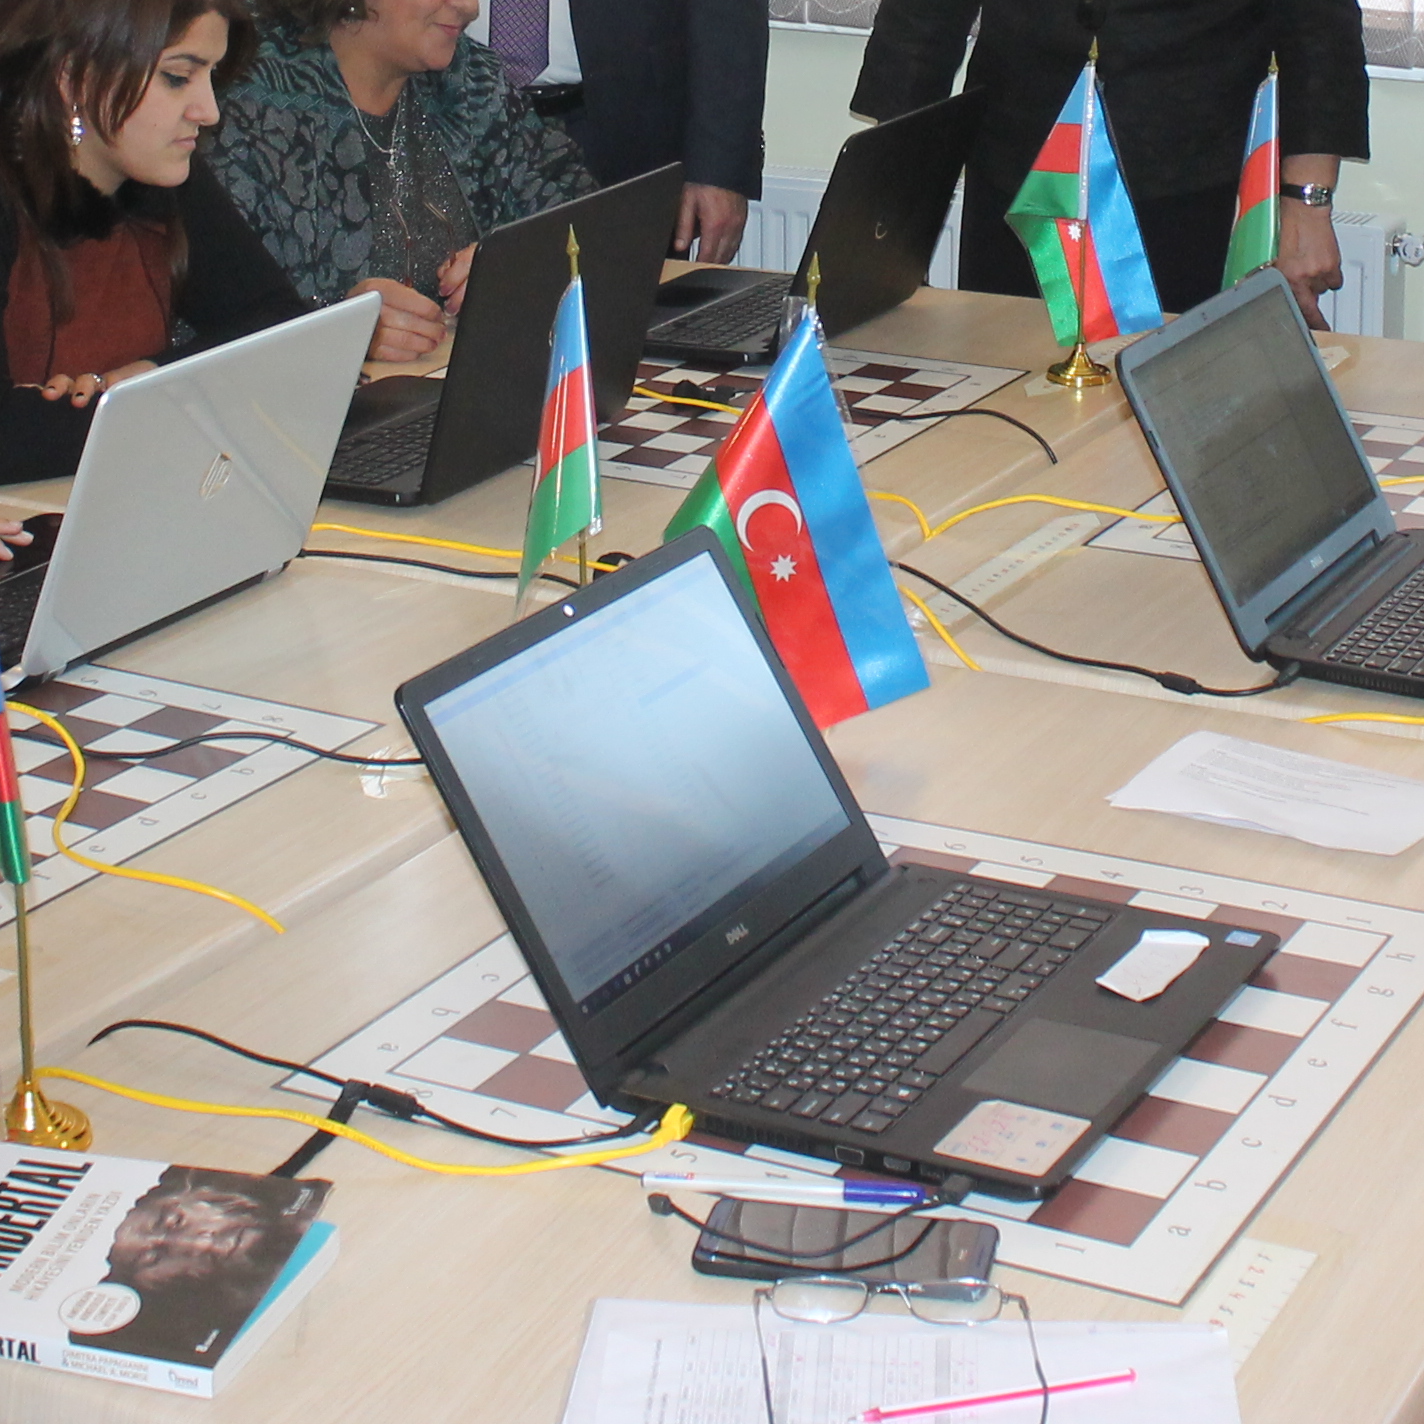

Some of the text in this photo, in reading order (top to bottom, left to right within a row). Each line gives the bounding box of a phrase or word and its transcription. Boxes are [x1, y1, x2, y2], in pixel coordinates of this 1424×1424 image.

[1100, 868, 1125, 882] 4
[1179, 883, 1205, 896] 3
[1261, 898, 1288, 911] 2
[1387, 949, 1416, 963] h
[1367, 985, 1395, 998] g
[1331, 1018, 1358, 1031] f
[1307, 1057, 1328, 1070] e
[1268, 1094, 1297, 1108] d
[1241, 1136, 1262, 1149] c
[1195, 1178, 1228, 1193] b
[1167, 1224, 1191, 1237] a
